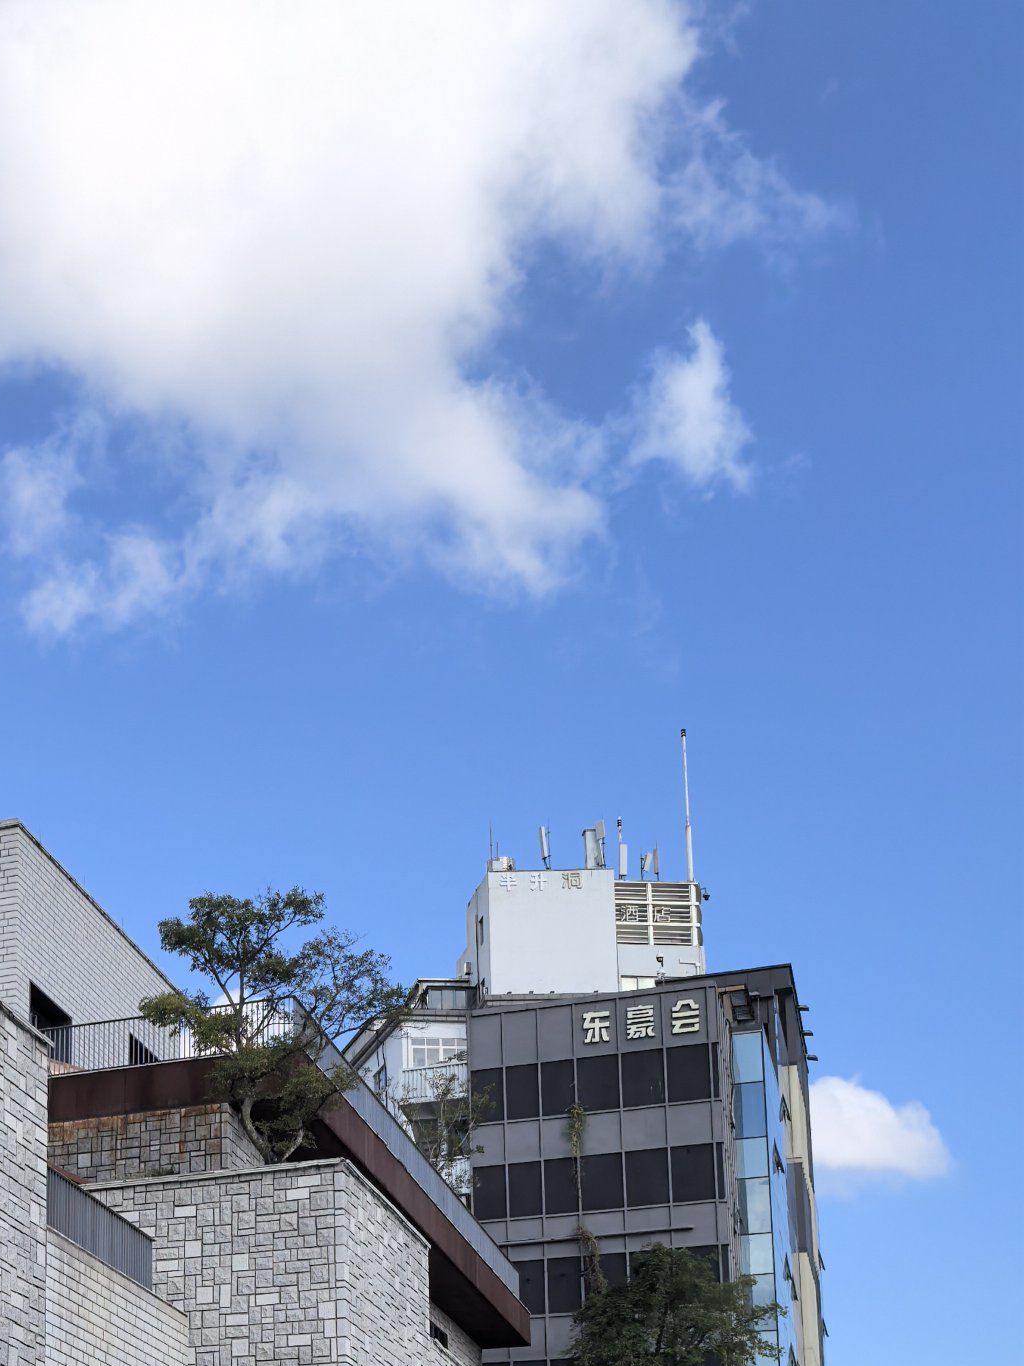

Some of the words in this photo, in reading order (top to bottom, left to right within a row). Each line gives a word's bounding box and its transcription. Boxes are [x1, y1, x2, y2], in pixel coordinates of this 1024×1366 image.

[499, 872, 583, 892] 半升洞
[582, 998, 701, 1045] 东豪会
